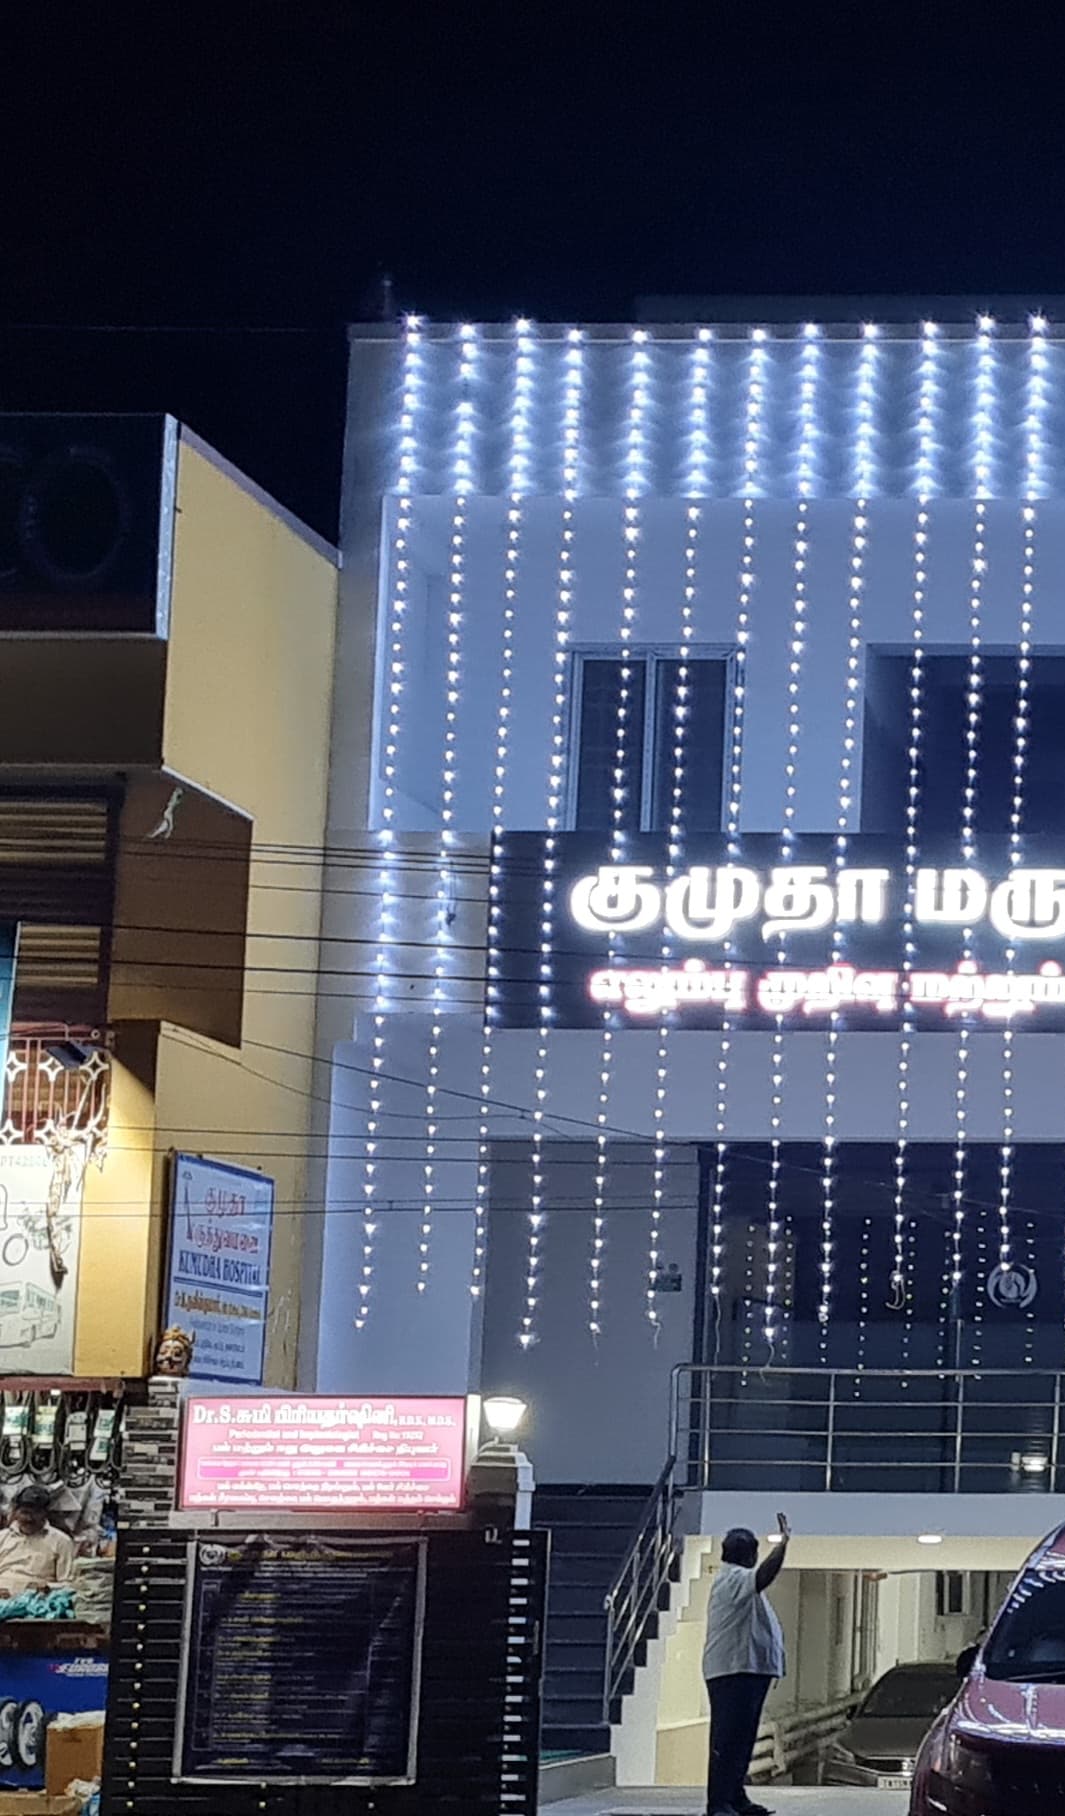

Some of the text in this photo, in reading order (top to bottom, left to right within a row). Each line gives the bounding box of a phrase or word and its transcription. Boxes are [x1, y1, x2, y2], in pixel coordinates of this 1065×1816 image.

[571, 865, 891, 942] குமுதா
[589, 958, 748, 1016] எலும்பு
[757, 962, 898, 1015] முறிவு
[223, 1258, 262, 1285] HOSPITAL
